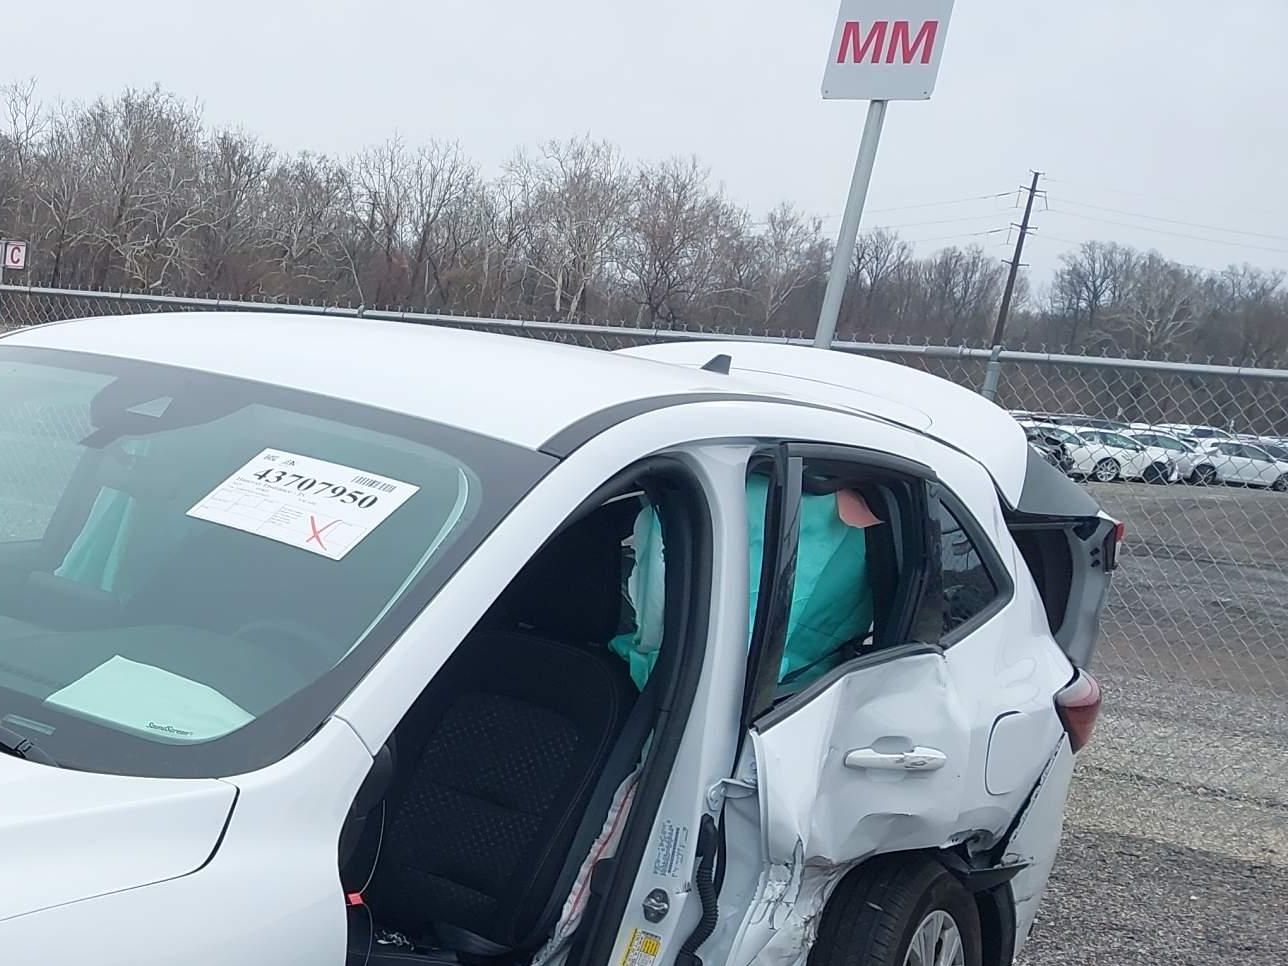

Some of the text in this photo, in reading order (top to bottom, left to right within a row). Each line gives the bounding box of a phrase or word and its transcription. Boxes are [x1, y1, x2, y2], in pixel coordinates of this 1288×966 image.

[836, 20, 939, 65] MM
[10, 246, 21, 265] C
[253, 467, 379, 509] 43707950
